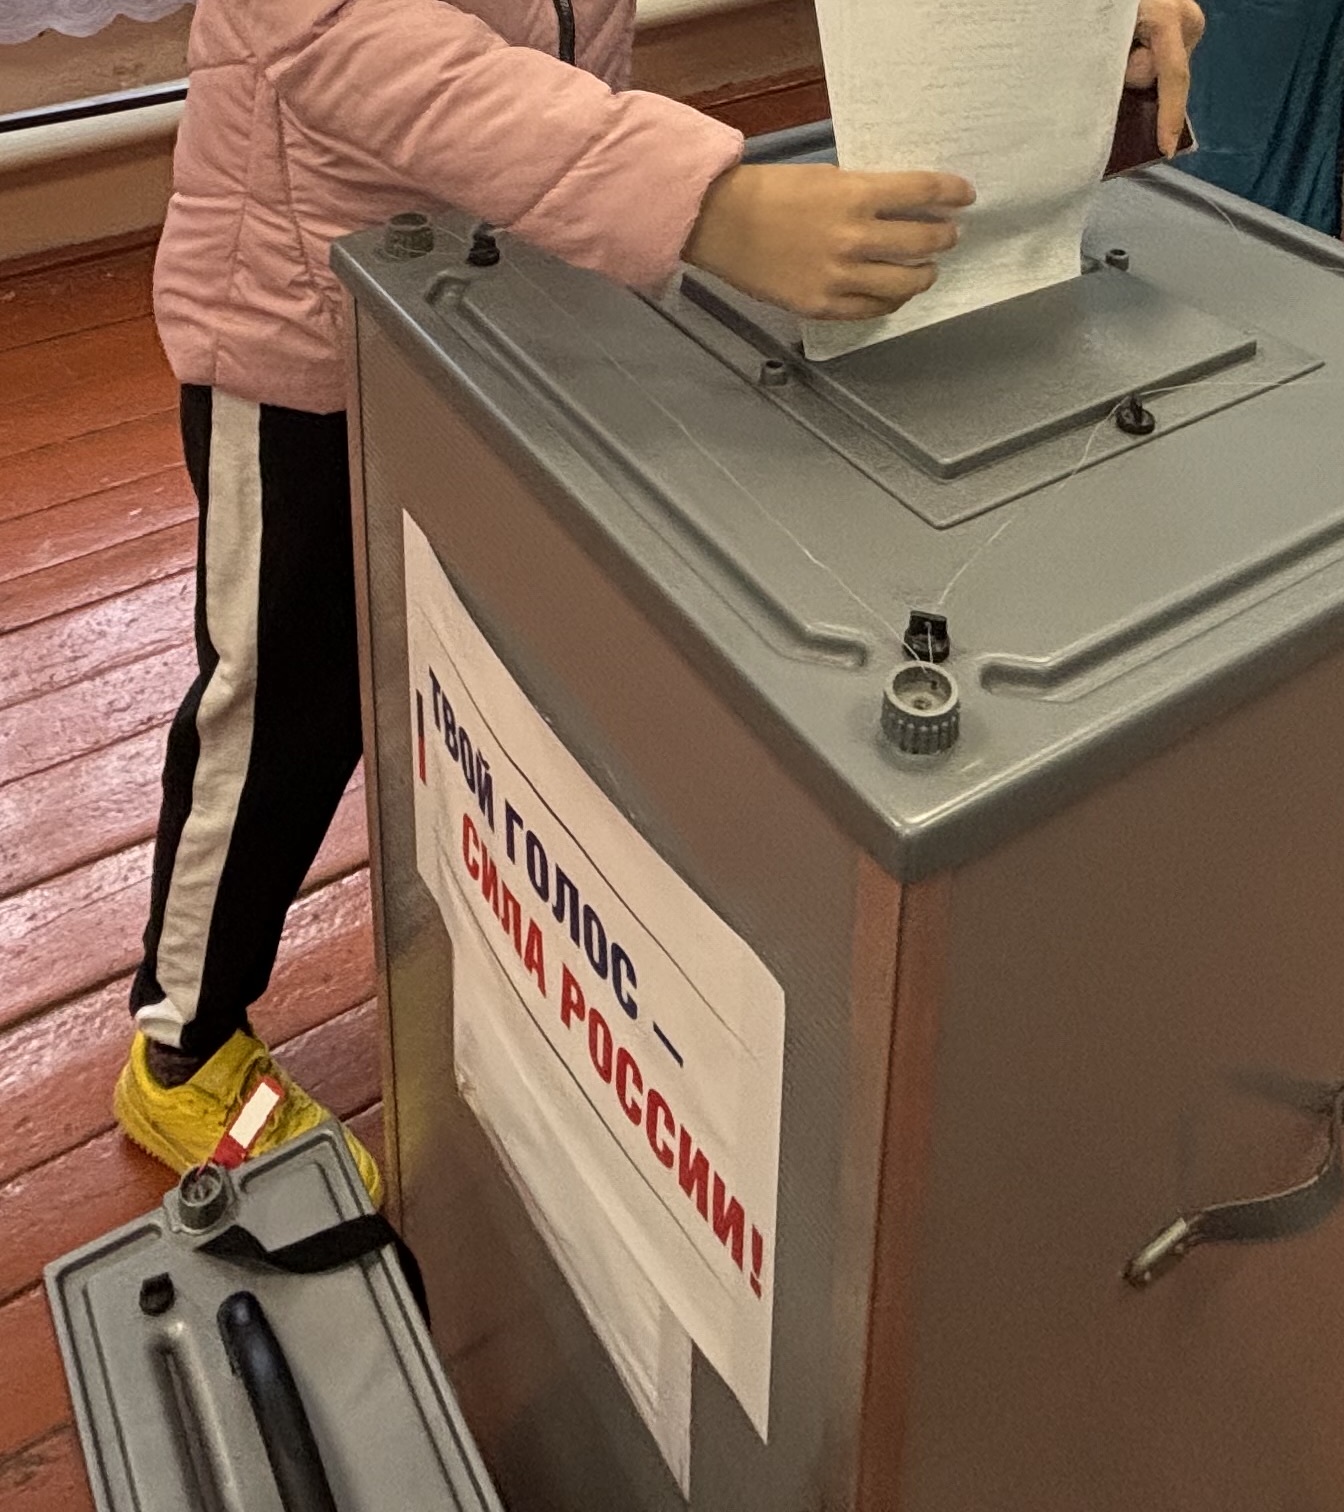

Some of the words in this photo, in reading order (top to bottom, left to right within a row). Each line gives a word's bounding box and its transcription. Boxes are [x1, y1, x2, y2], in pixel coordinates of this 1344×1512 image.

[429, 665, 494, 833] ТВОЙ
[505, 798, 637, 1020] ГОЛОС
[462, 813, 547, 999] СИЛА
[560, 962, 764, 1301] РОССИИ!
